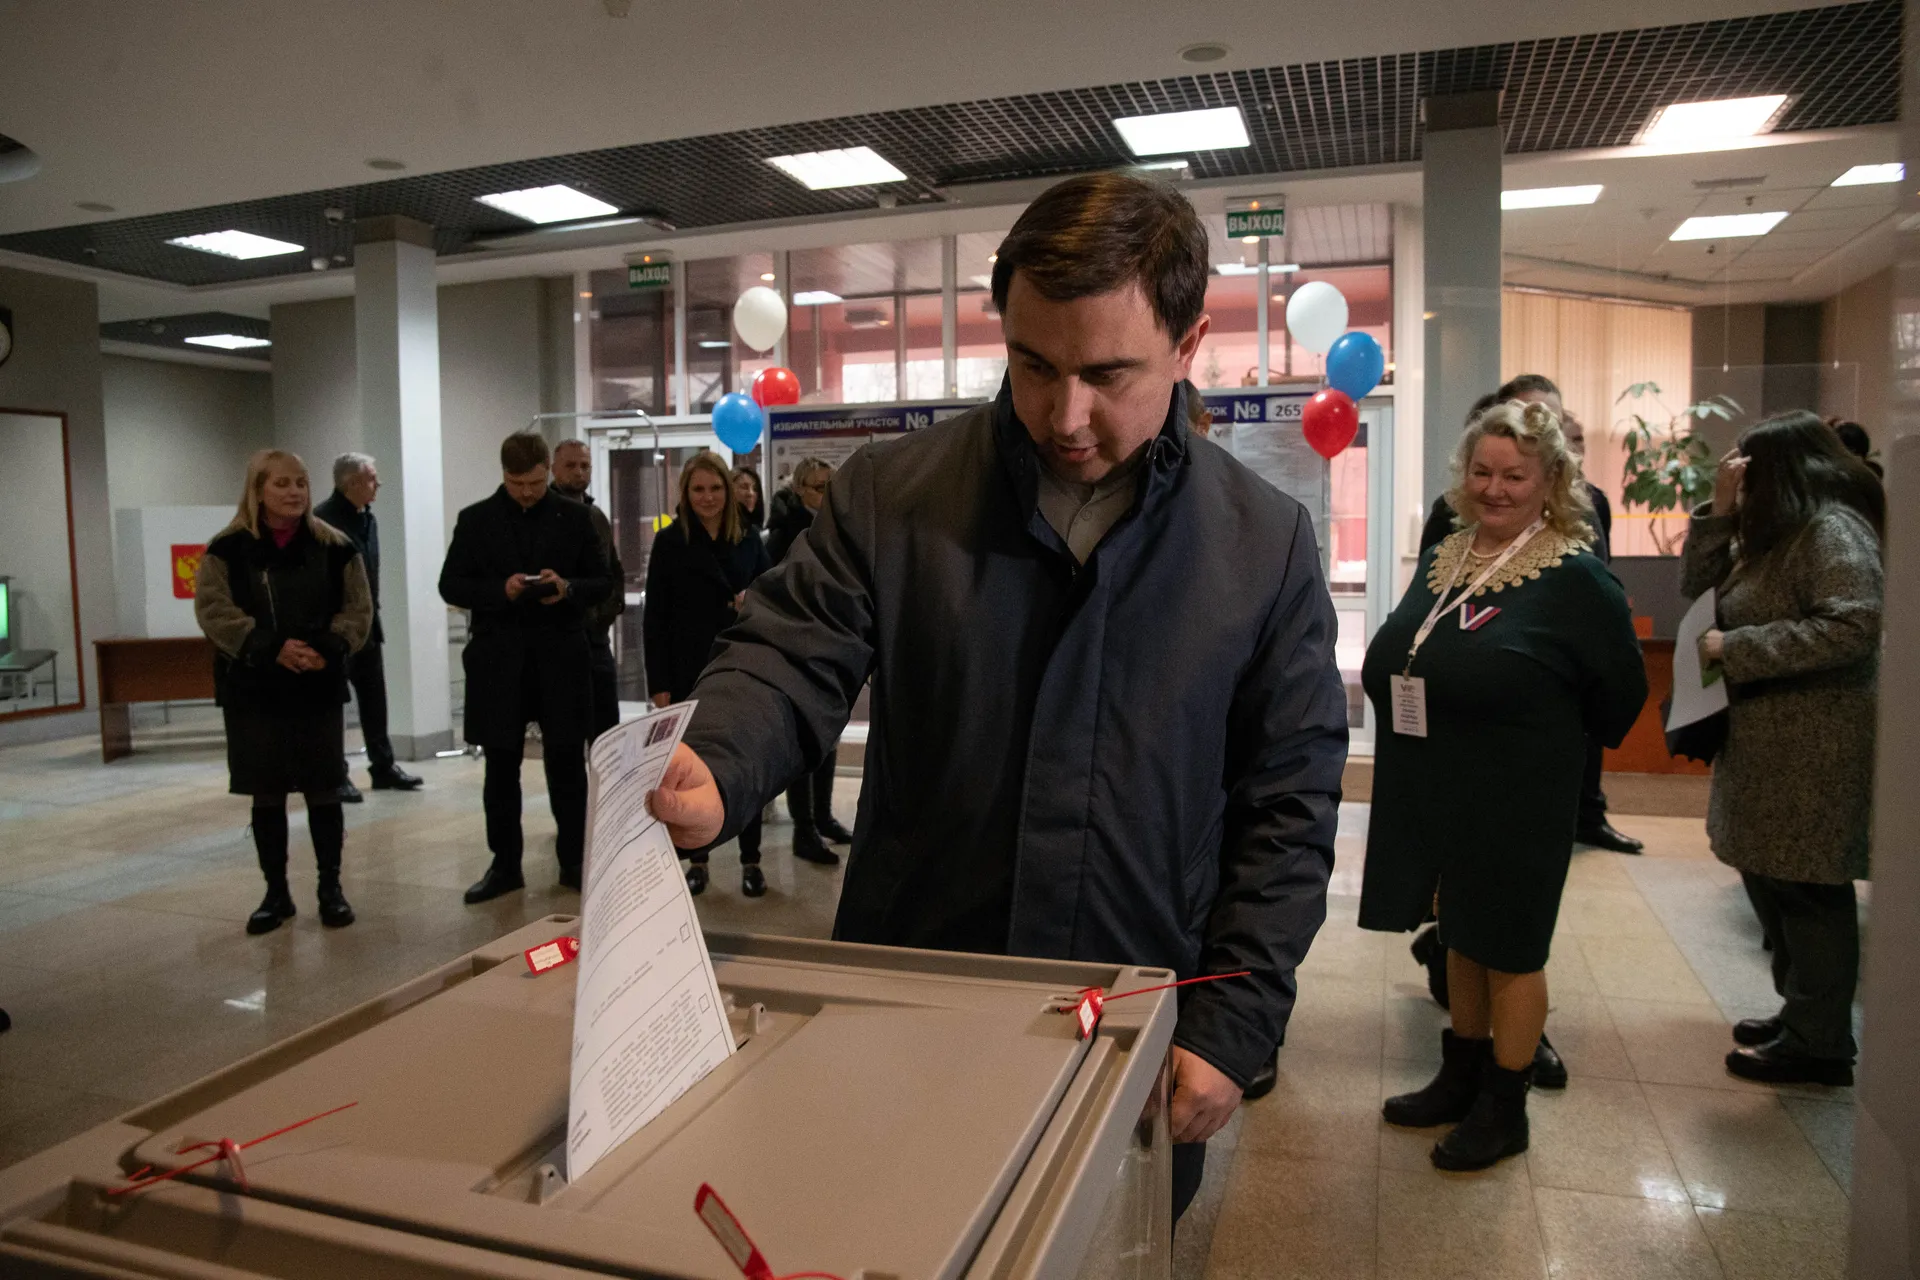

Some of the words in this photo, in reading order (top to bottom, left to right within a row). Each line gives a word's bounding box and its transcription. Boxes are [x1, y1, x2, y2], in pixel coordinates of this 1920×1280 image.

[1229, 214, 1282, 232] ВЫХОД
[630, 266, 669, 283] ВЫХОД
[1234, 400, 1260, 420] №
[774, 419, 855, 431] ИЗБИРАТЕЛЬНЫЙ
[856, 417, 899, 429] УЧАСТОК
[905, 412, 929, 429] №
